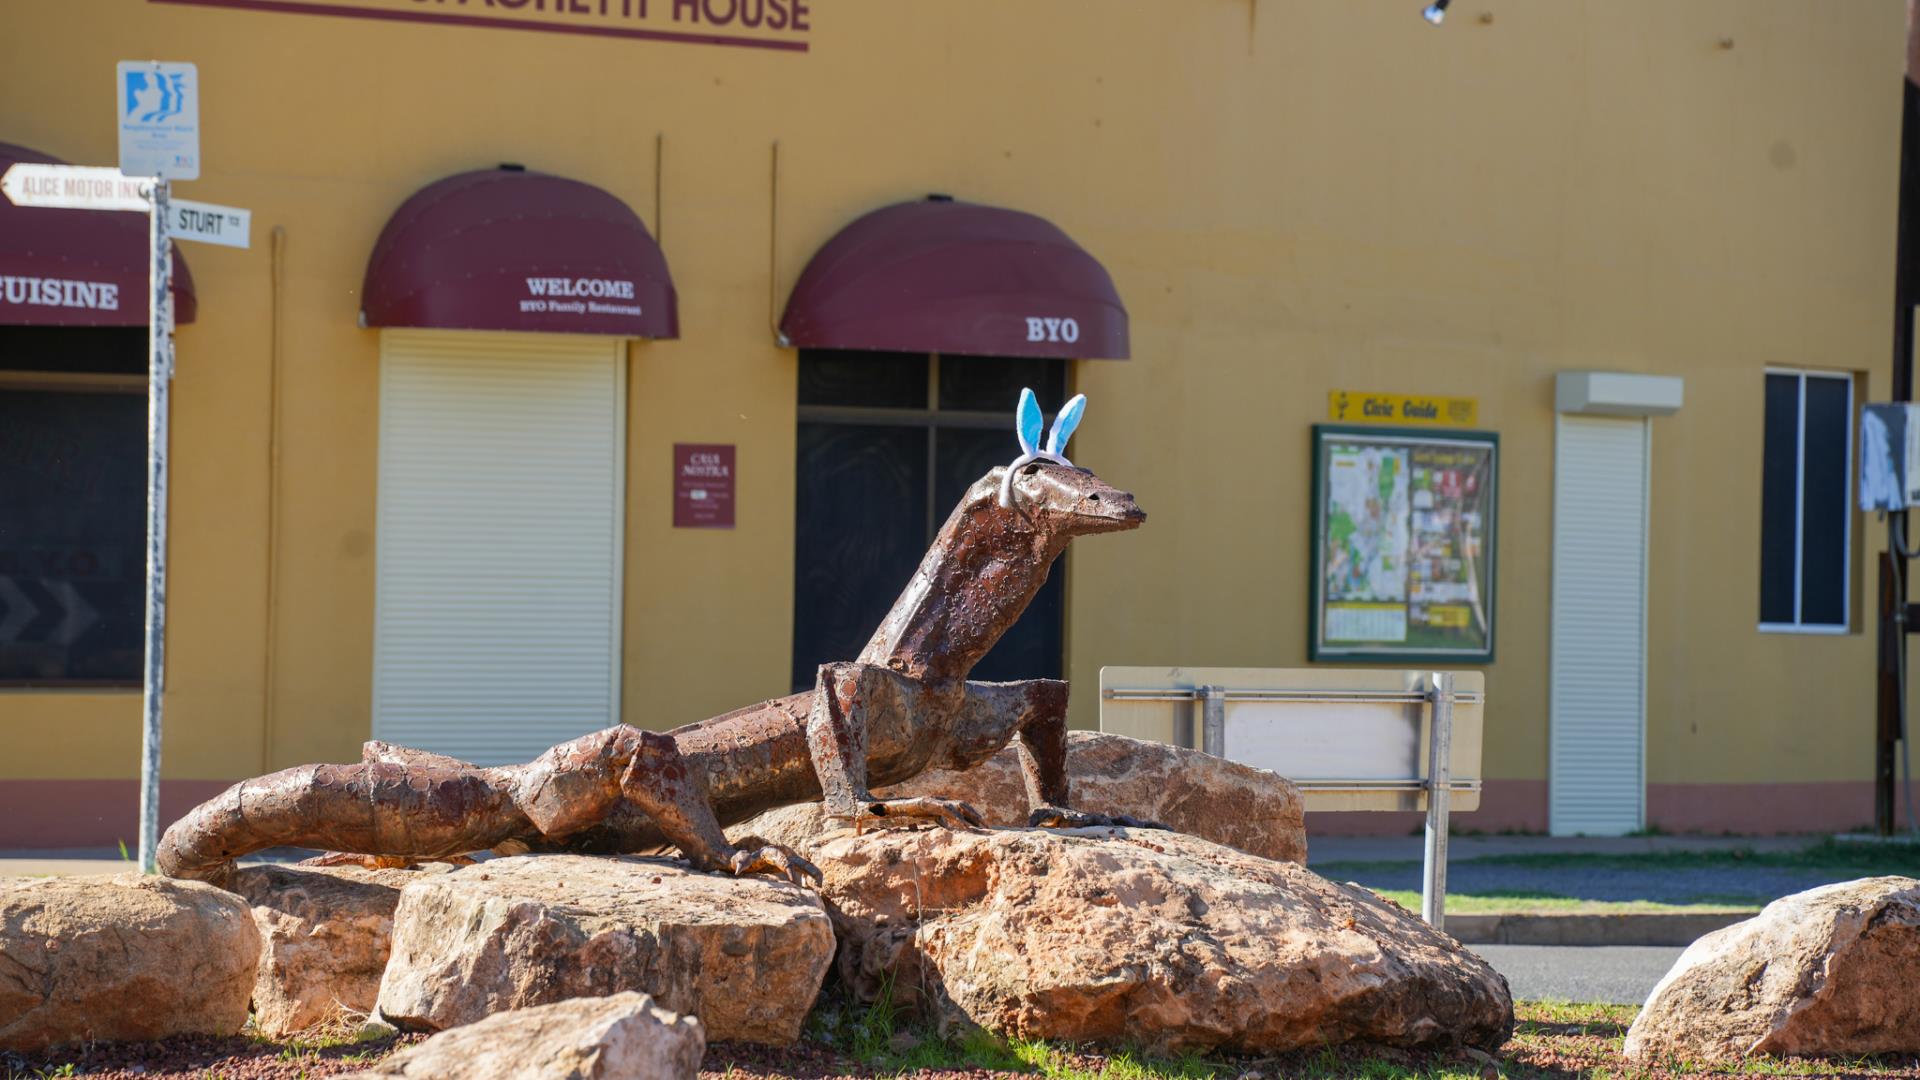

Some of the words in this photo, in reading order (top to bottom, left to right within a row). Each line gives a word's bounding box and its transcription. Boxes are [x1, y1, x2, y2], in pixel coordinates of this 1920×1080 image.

[672, 0, 809, 31] HOUSE
[22, 176, 59, 196] ALICE
[64, 178, 113, 199] MOTOR
[179, 208, 224, 235] STURT
[0, 275, 118, 310] UISINE
[526, 277, 634, 299] WELCOME
[520, 300, 546, 312] BYO
[548, 300, 585, 315] Family
[1025, 317, 1079, 343] BYO
[1363, 397, 1394, 417] Civic
[1402, 400, 1438, 419] Guide
